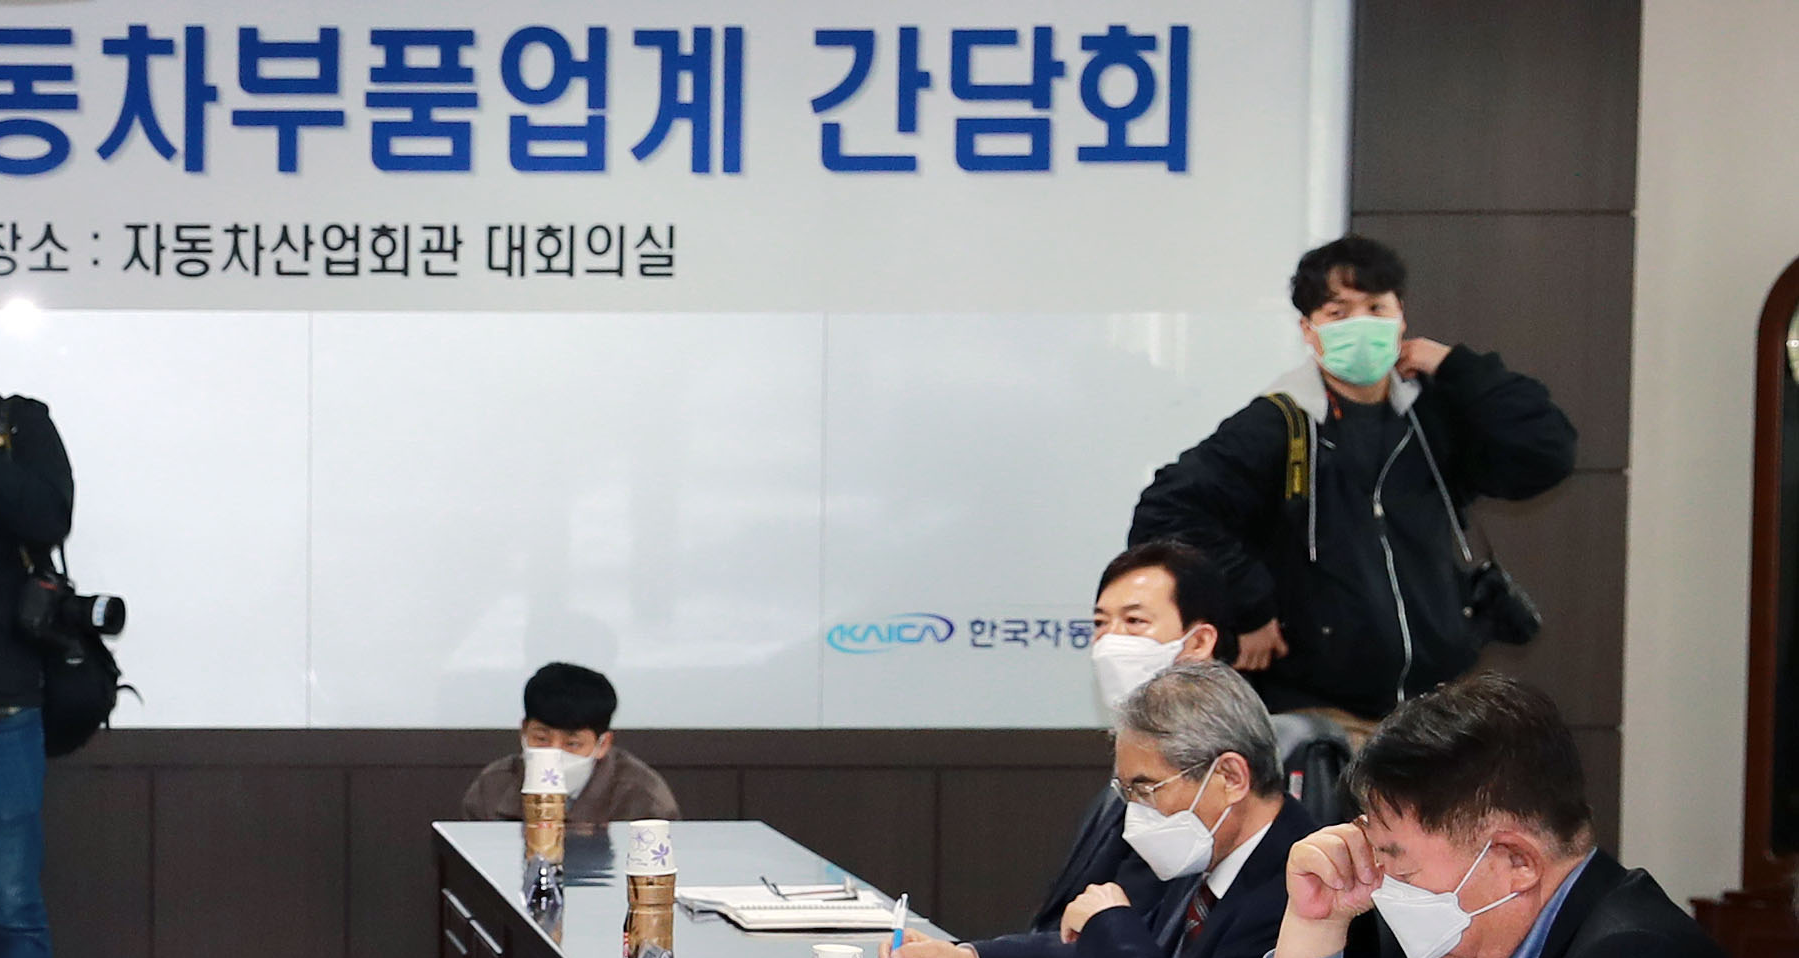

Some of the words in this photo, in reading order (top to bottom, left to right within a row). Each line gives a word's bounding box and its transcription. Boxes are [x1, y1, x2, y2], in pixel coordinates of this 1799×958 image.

[811, 24, 1190, 174] 간담회
[122, 222, 464, 279] 자동차산업회관
[486, 223, 676, 279] 대회의실
[970, 618, 1094, 650] 한국자동
